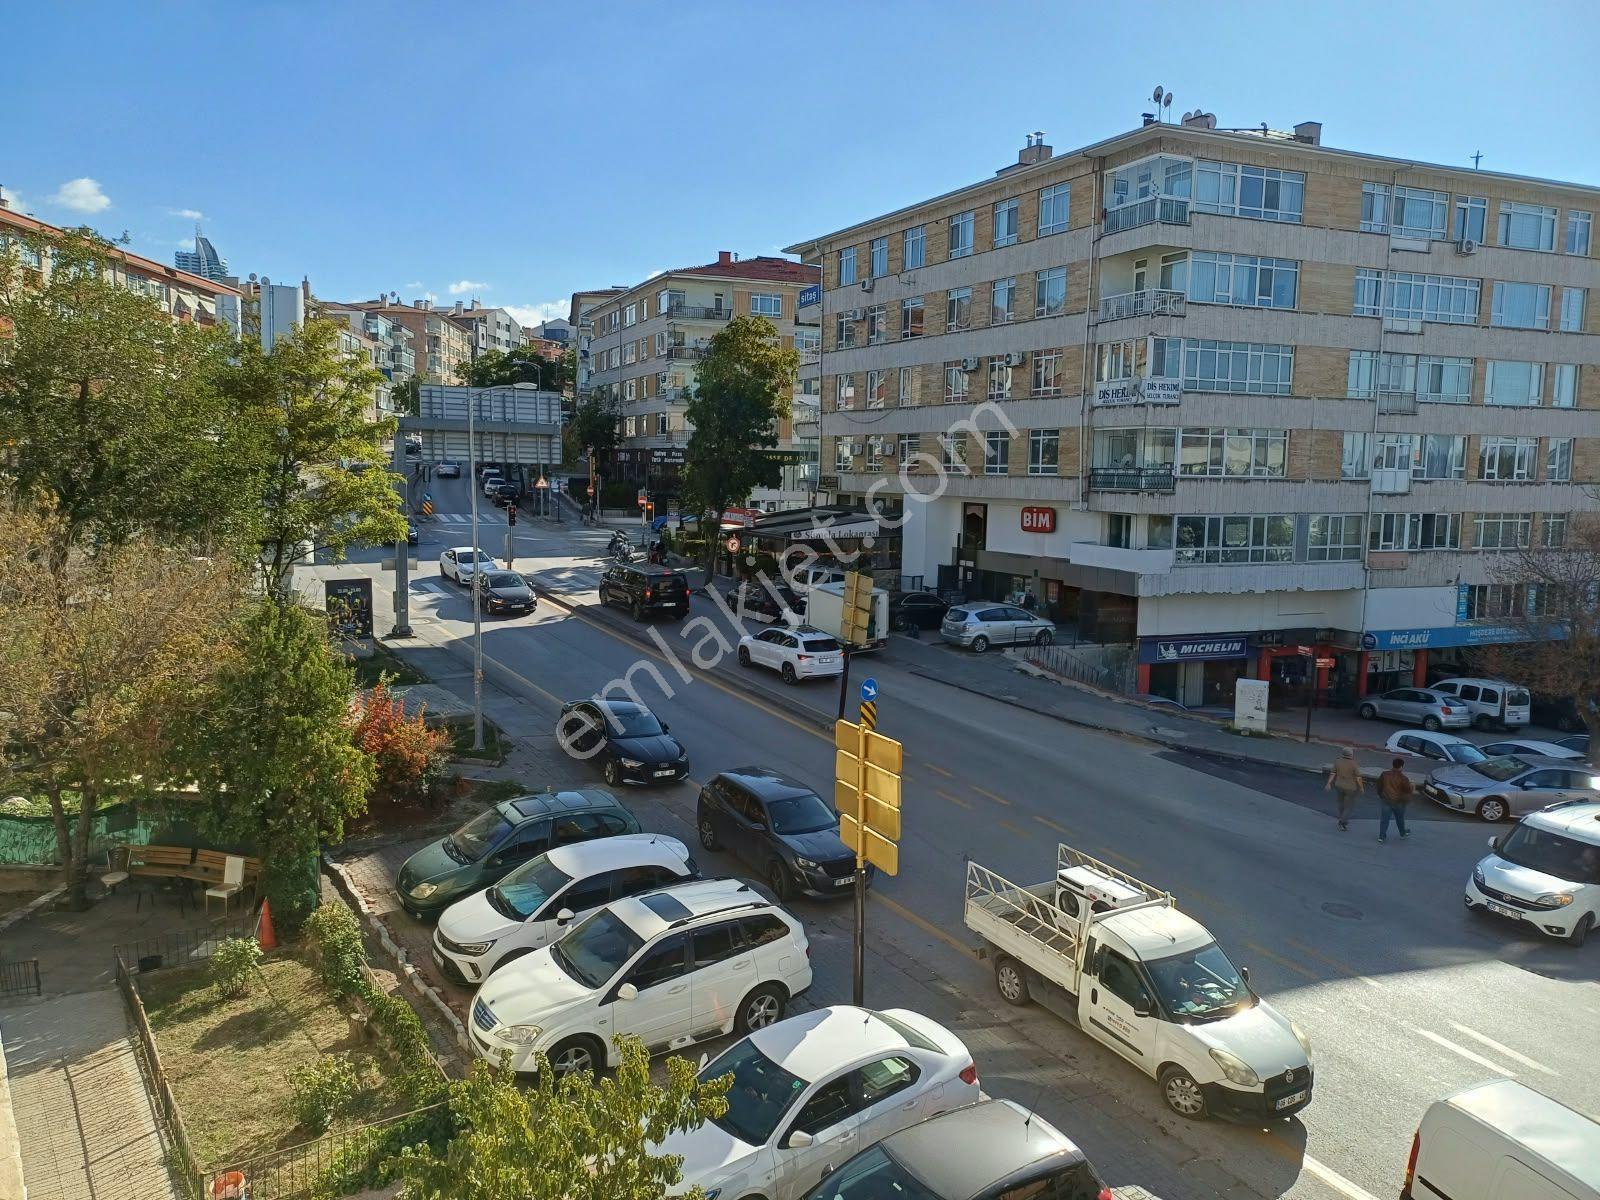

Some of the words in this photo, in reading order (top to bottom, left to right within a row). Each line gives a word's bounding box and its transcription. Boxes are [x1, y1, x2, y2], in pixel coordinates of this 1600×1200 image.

[1023, 508, 1051, 528] BİM
[1409, 630, 1431, 644] AKÜ
[1180, 642, 1242, 654] MICHELIN
